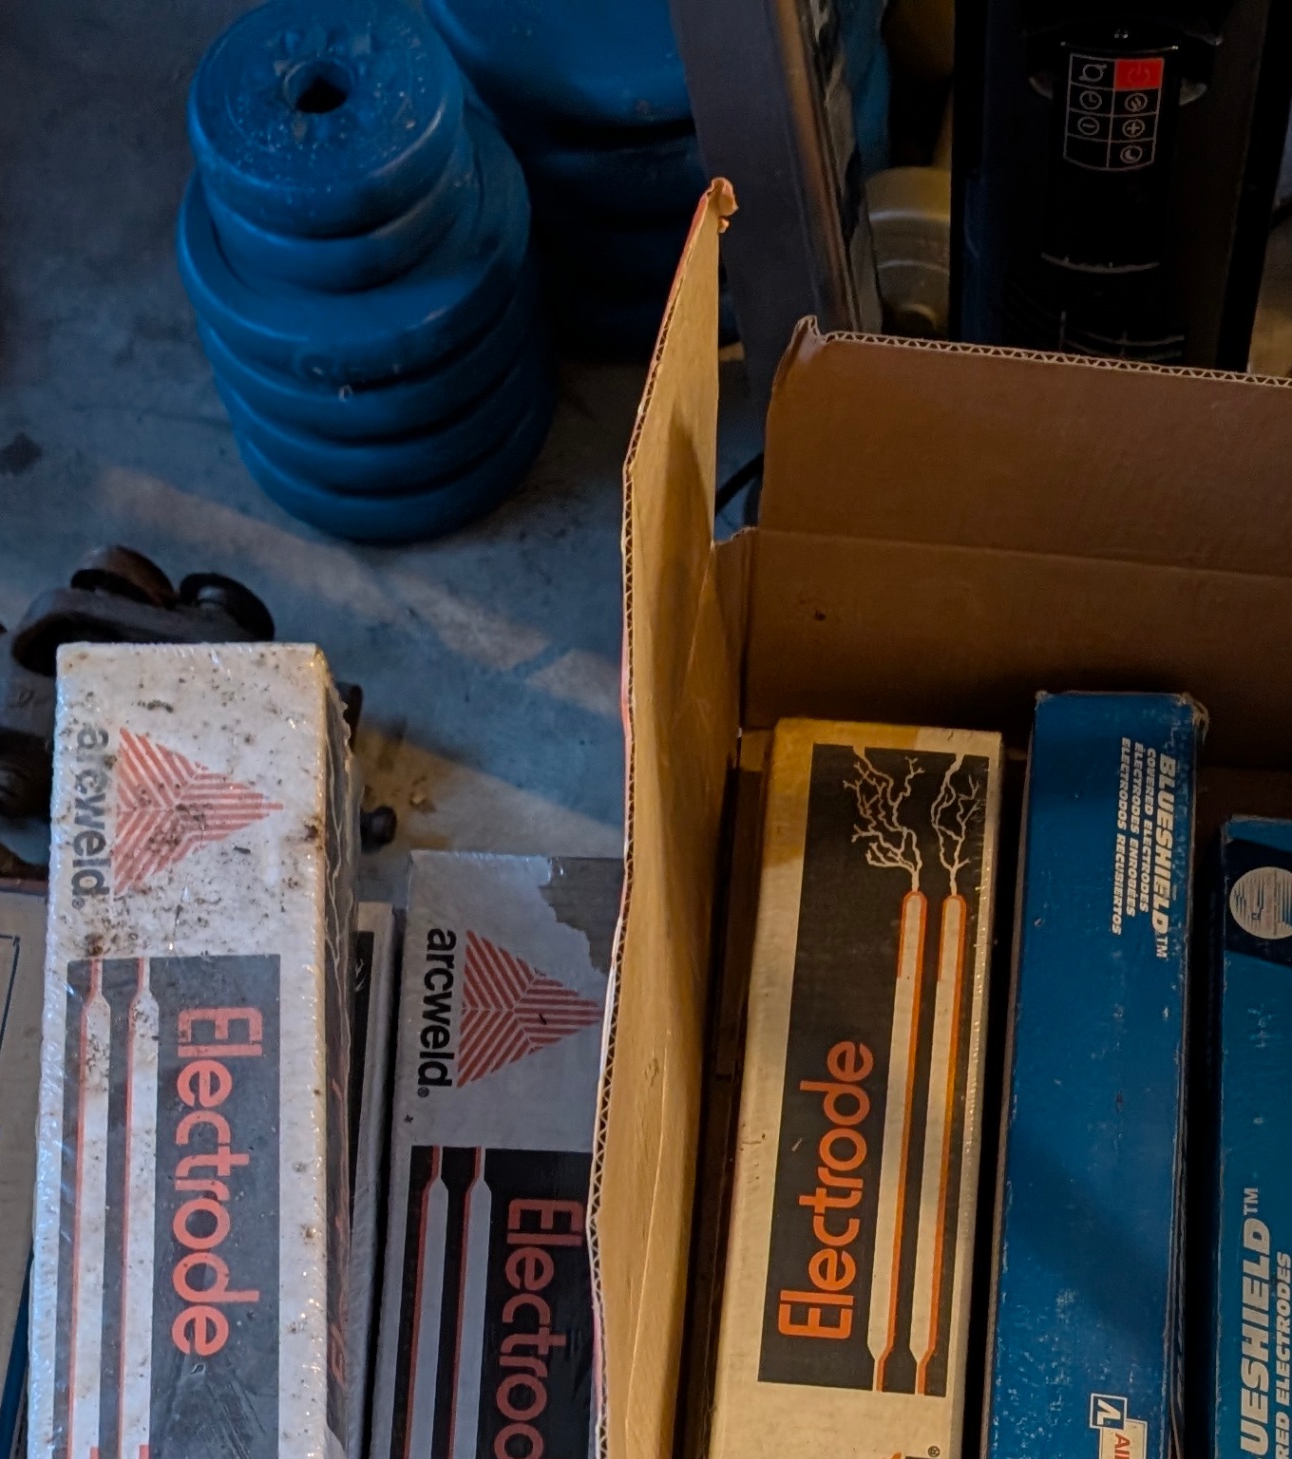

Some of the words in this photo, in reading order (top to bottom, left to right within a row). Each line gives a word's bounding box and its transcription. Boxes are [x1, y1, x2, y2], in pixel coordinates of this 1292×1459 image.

[1117, 737, 1131, 831] ELECTRODOS
[1144, 747, 1156, 816] COVERED
[1111, 833, 1127, 936] RECUBIERTOS
[1139, 819, 1153, 913] ELECTRODES
[171, 1005, 264, 1357] Electrode
[778, 1040, 874, 1341] Electrode
[1275, 1250, 1292, 1408] ELECTRODES
